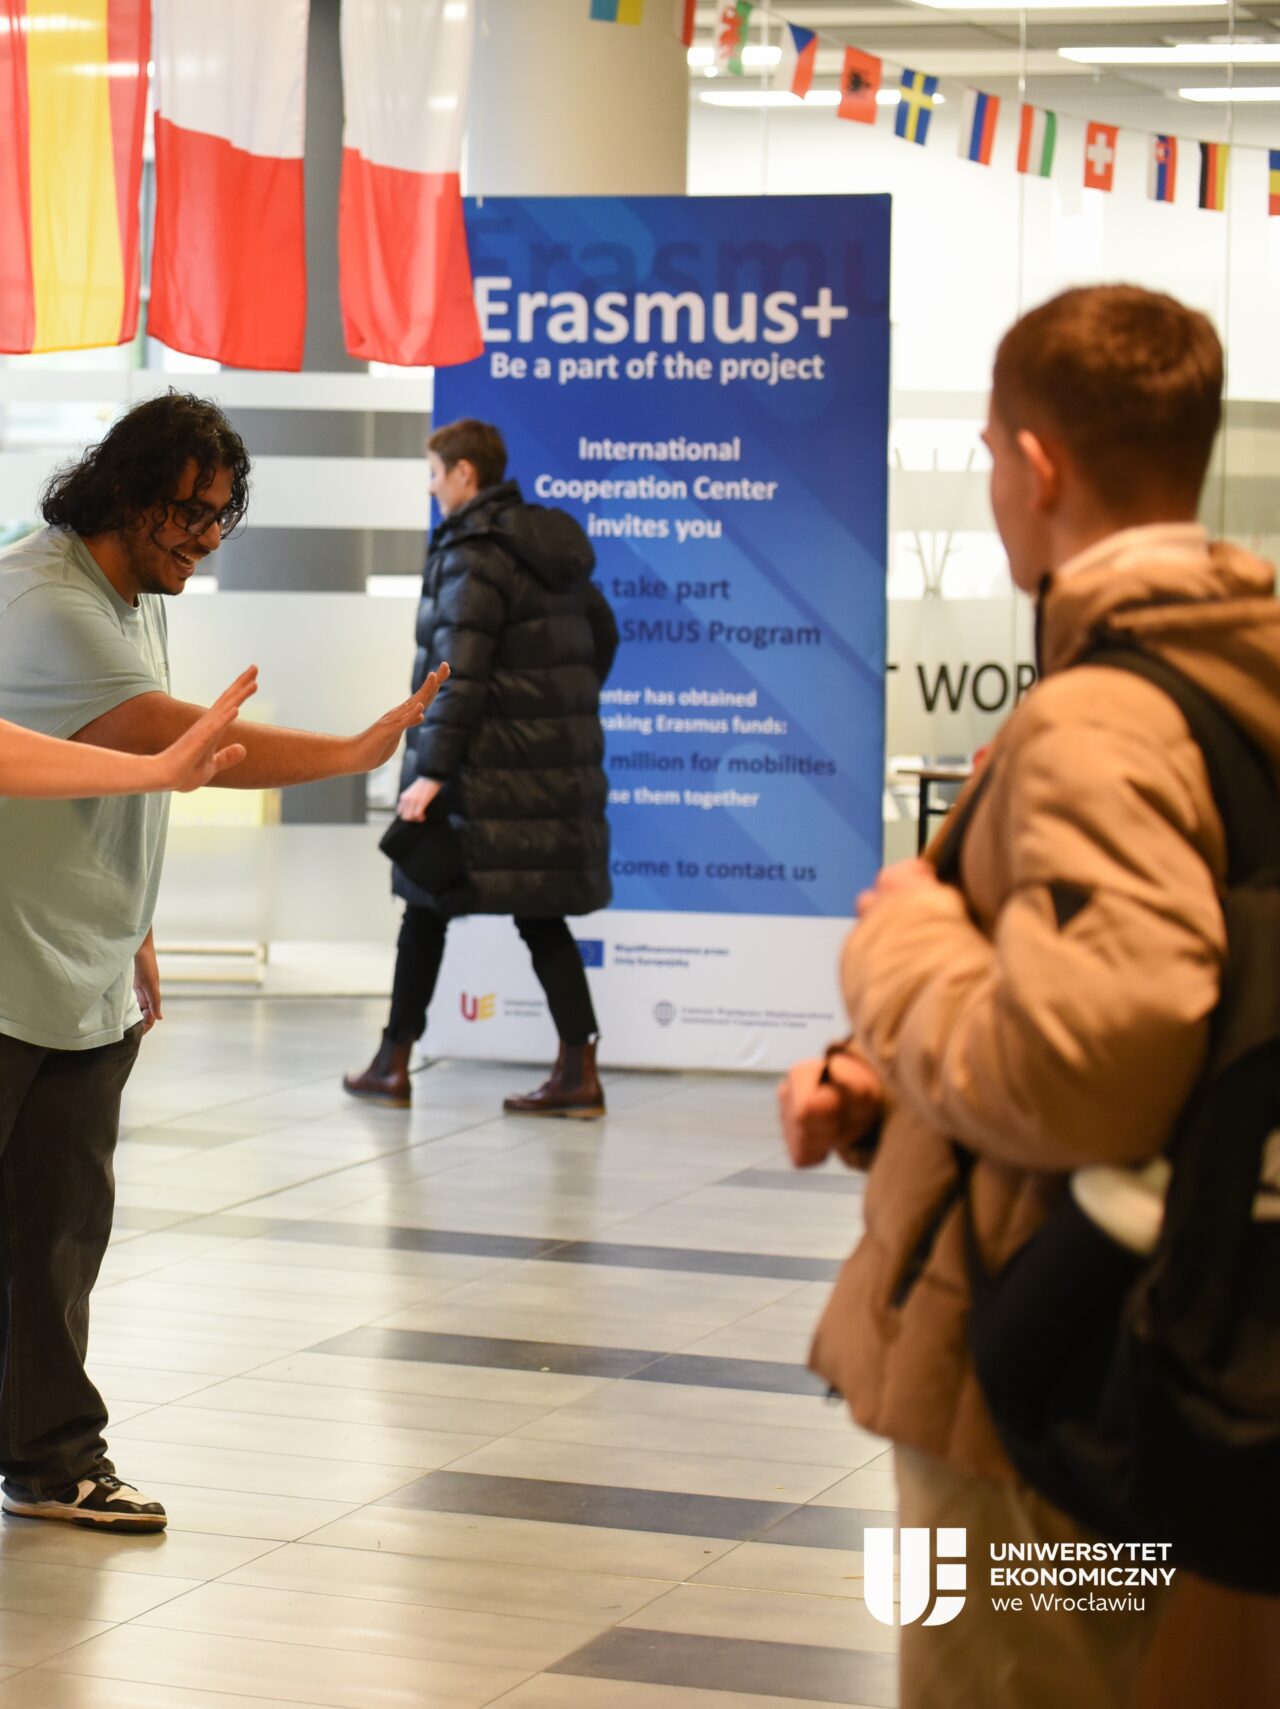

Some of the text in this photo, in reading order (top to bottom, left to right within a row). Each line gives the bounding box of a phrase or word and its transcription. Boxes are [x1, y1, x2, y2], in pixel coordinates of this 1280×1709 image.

[473, 276, 849, 344] Erasmus+
[491, 351, 825, 386] Be a part of the project
[579, 436, 741, 461] International
[534, 474, 778, 504] Cooperation Center
[587, 512, 723, 544] invites you
[612, 574, 668, 599] take
[676, 577, 731, 604] part
[710, 620, 821, 649] Program
[644, 687, 675, 706] has
[678, 688, 757, 708] obtained
[655, 714, 729, 733] Erasmus
[732, 715, 788, 735] funds:
[610, 752, 837, 776] million for mobilities
[633, 786, 680, 805] them
[684, 787, 759, 809] together
[677, 858, 699, 878] to
[705, 860, 785, 880] contact
[792, 864, 817, 881] us
